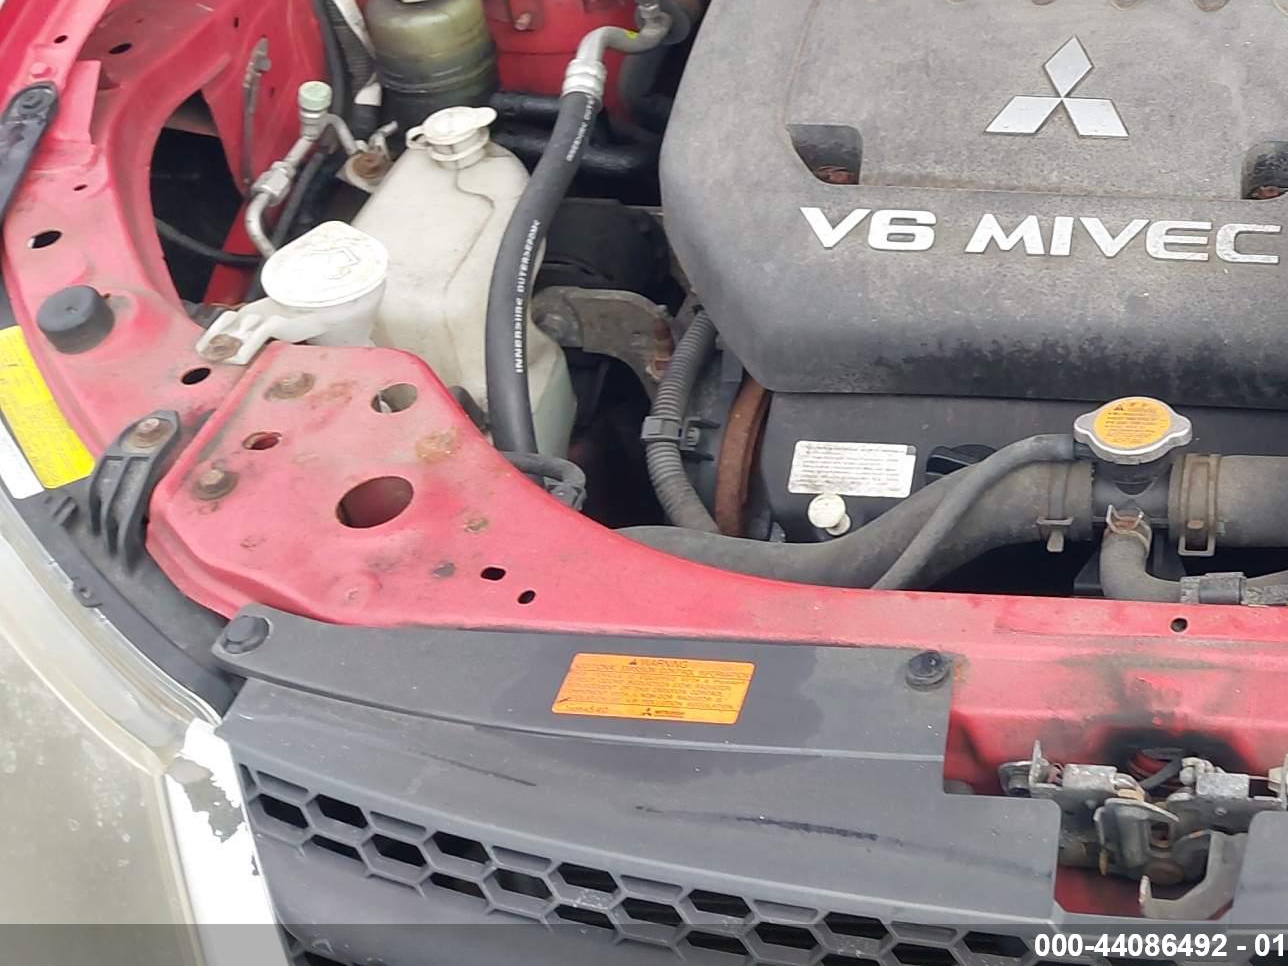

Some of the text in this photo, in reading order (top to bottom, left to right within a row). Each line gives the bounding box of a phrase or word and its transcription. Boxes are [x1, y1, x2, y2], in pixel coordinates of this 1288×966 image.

[800, 207, 1281, 264] V6 MIVEC
[640, 659, 689, 669] WARNING
